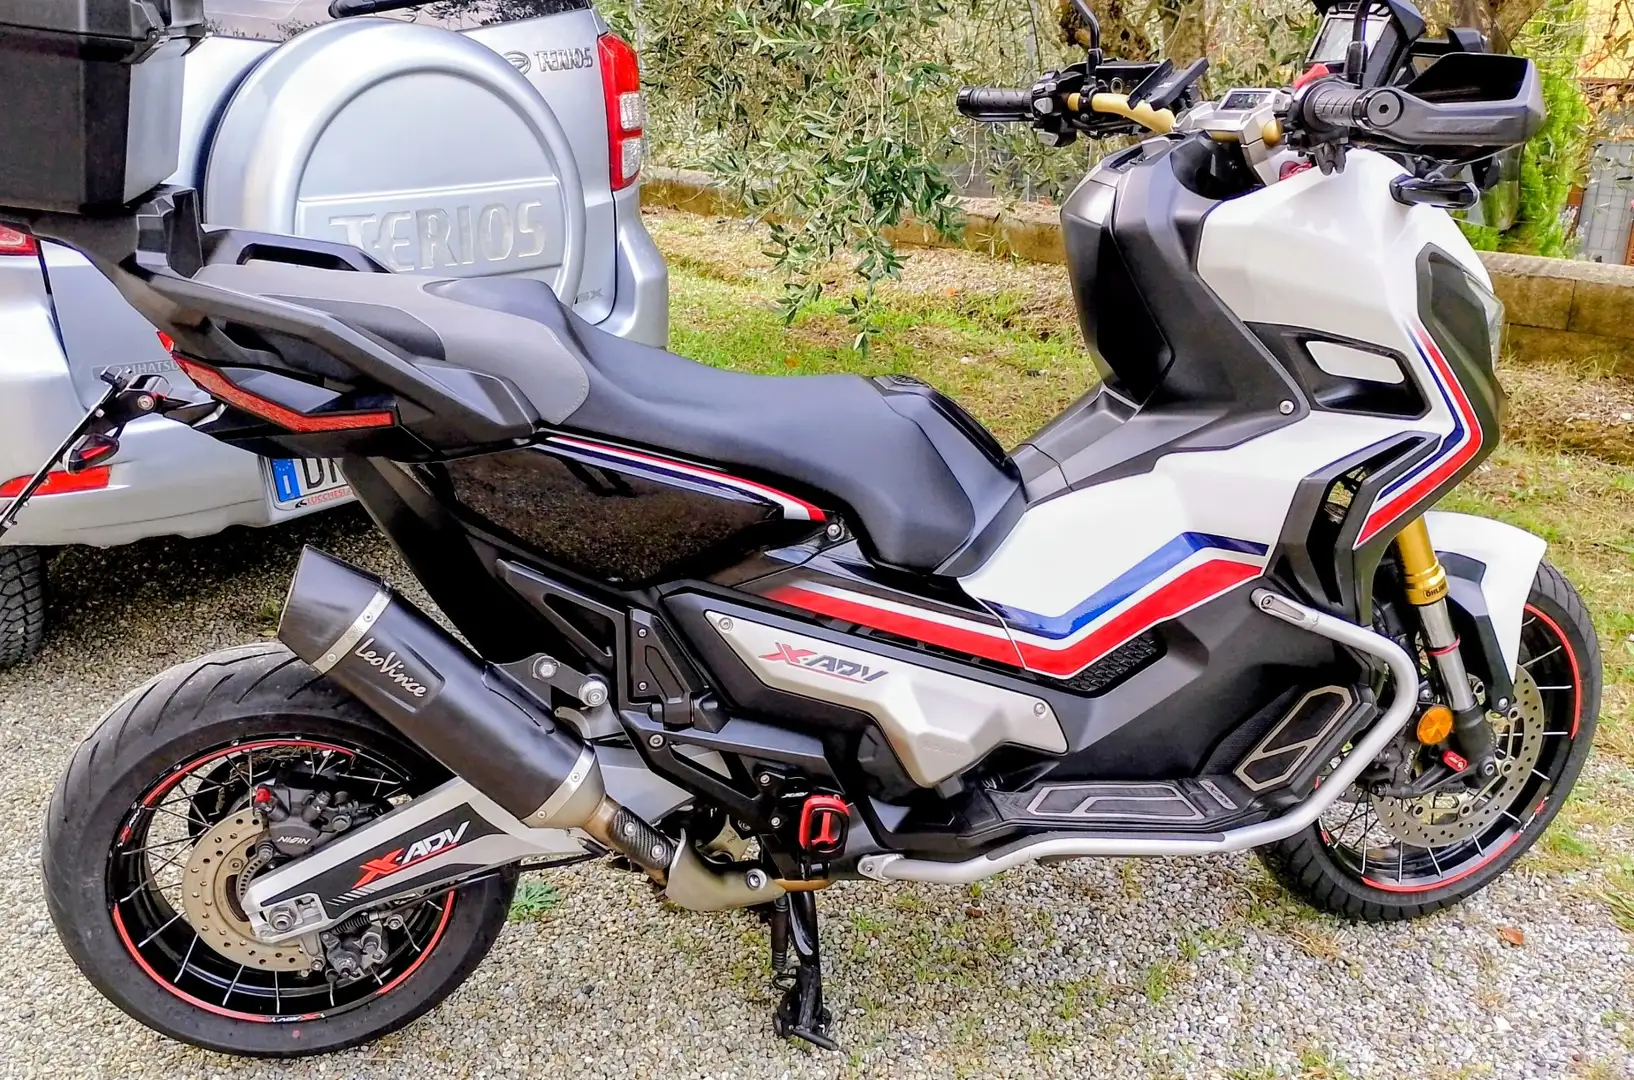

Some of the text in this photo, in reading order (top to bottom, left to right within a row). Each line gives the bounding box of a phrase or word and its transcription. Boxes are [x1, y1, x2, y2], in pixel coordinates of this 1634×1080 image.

[533, 47, 593, 72] TERIOS
[328, 201, 546, 274] TERIOS
[114, 360, 180, 375] AIHATSU
[354, 637, 427, 697] LeoVince
[757, 641, 889, 684] X-ADV
[352, 820, 470, 889] X-ADV
